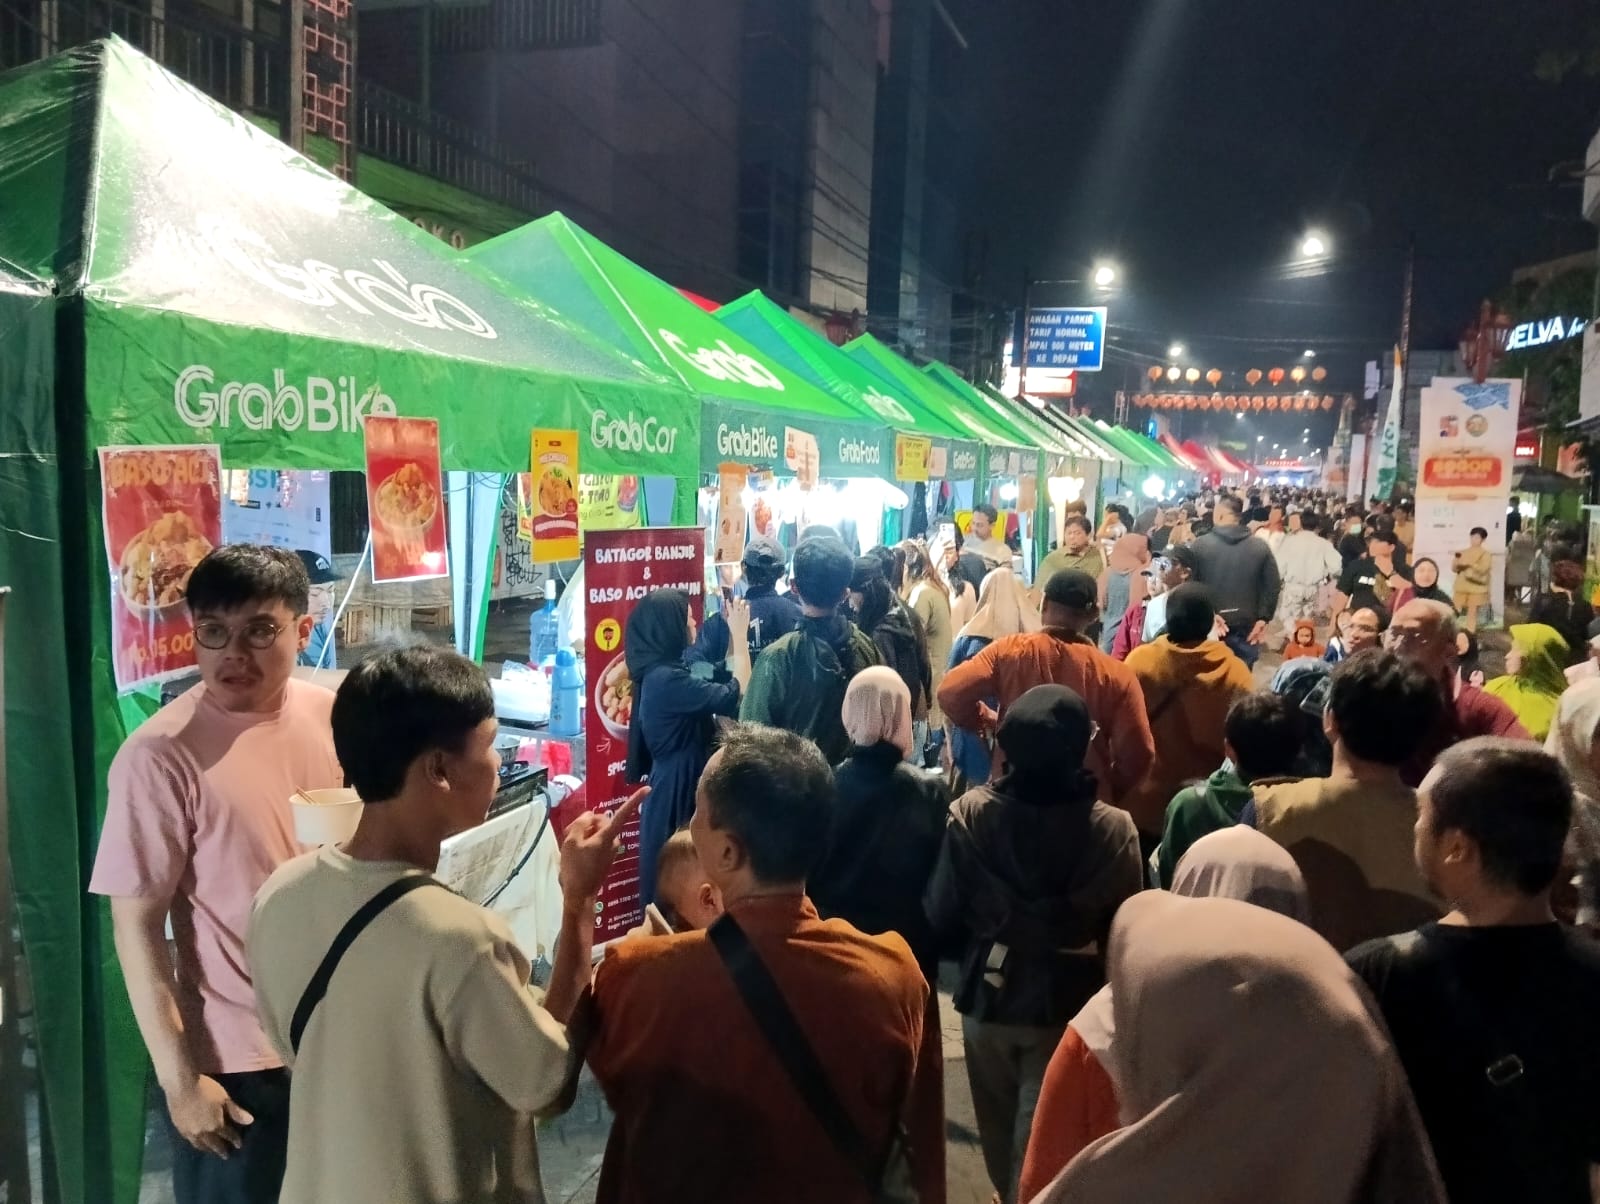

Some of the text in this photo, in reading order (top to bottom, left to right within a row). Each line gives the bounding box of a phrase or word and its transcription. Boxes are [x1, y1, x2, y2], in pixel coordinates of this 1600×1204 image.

[174, 365, 397, 433] GrabBike
[590, 409, 678, 454] GrabCar
[717, 423, 778, 459] GrabBike
[839, 437, 880, 465] GrabFood
[595, 545, 695, 564] BATAGOR BANJIR
[643, 566, 651, 580] &
[589, 588, 622, 604] BASO
